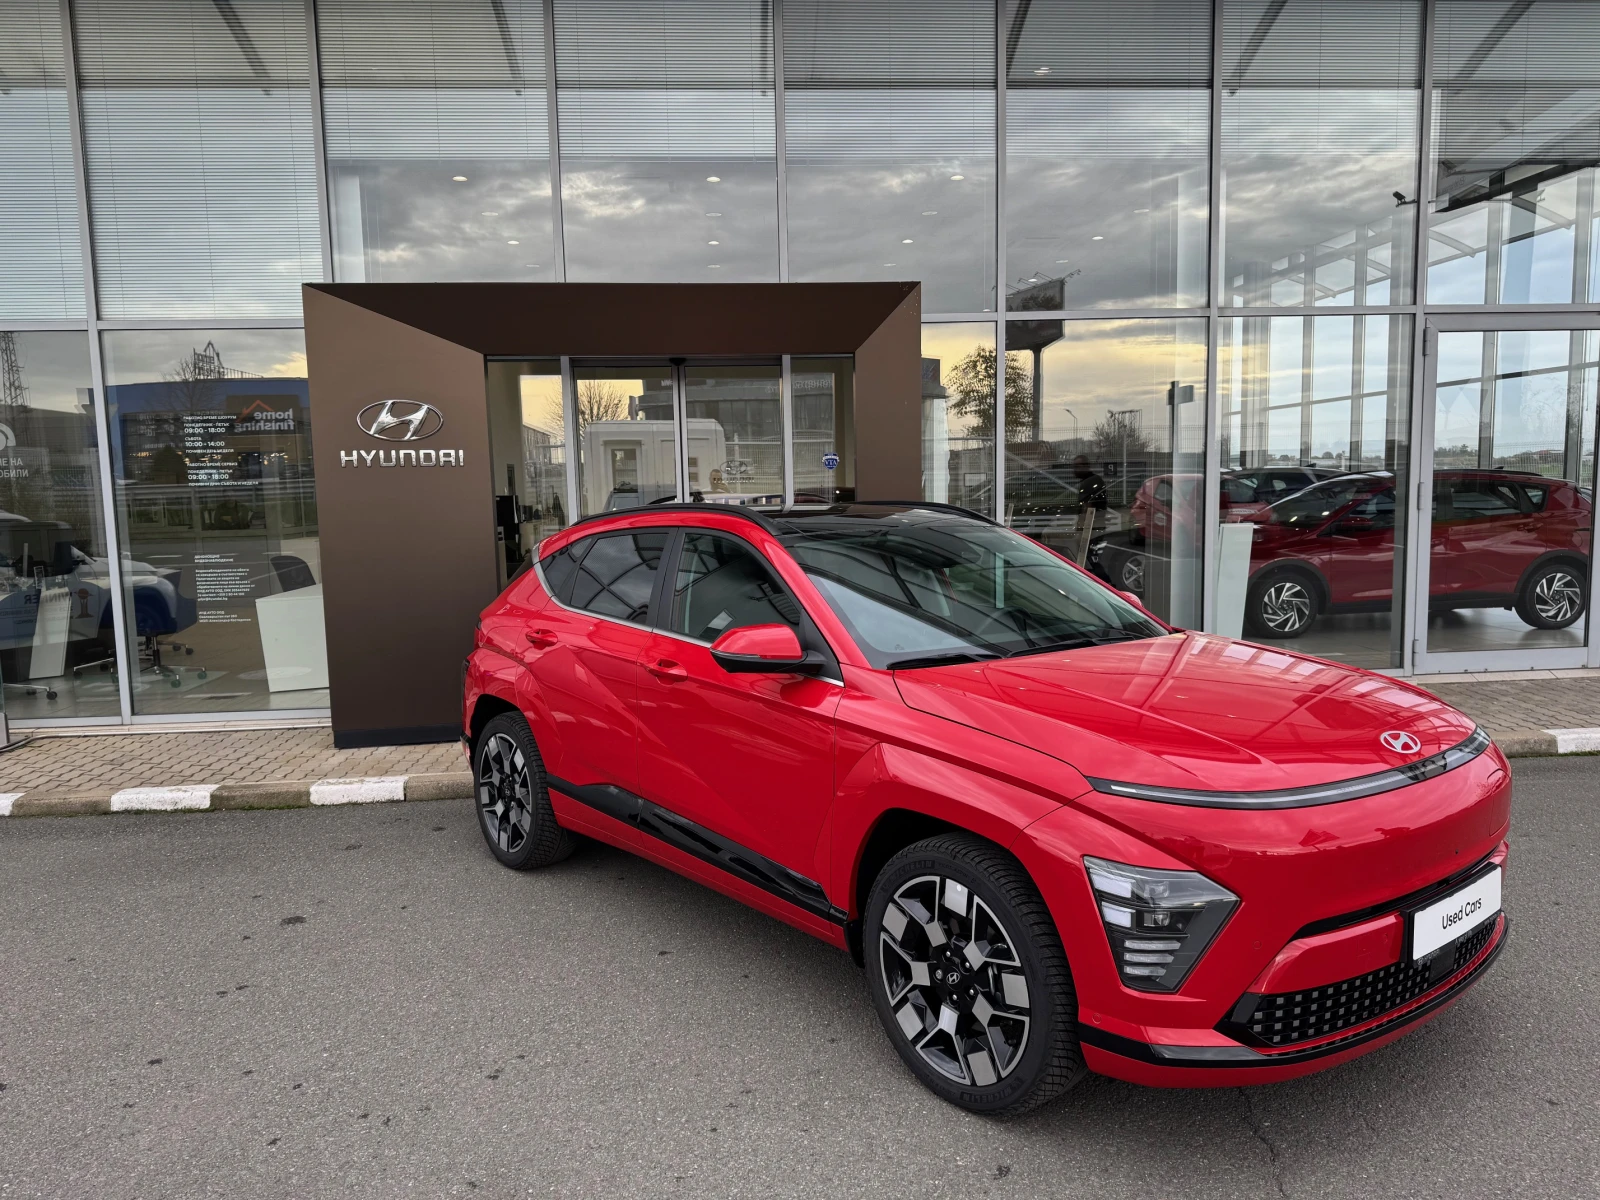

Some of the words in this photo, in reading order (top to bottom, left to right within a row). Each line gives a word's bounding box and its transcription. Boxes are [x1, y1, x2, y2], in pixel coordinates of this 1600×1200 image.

[0, 458, 8, 466] Е
[10, 458, 23, 466] НА
[340, 449, 464, 467] HYUNDAI
[1442, 905, 1463, 929] Used
[1464, 898, 1482, 917] Cars
